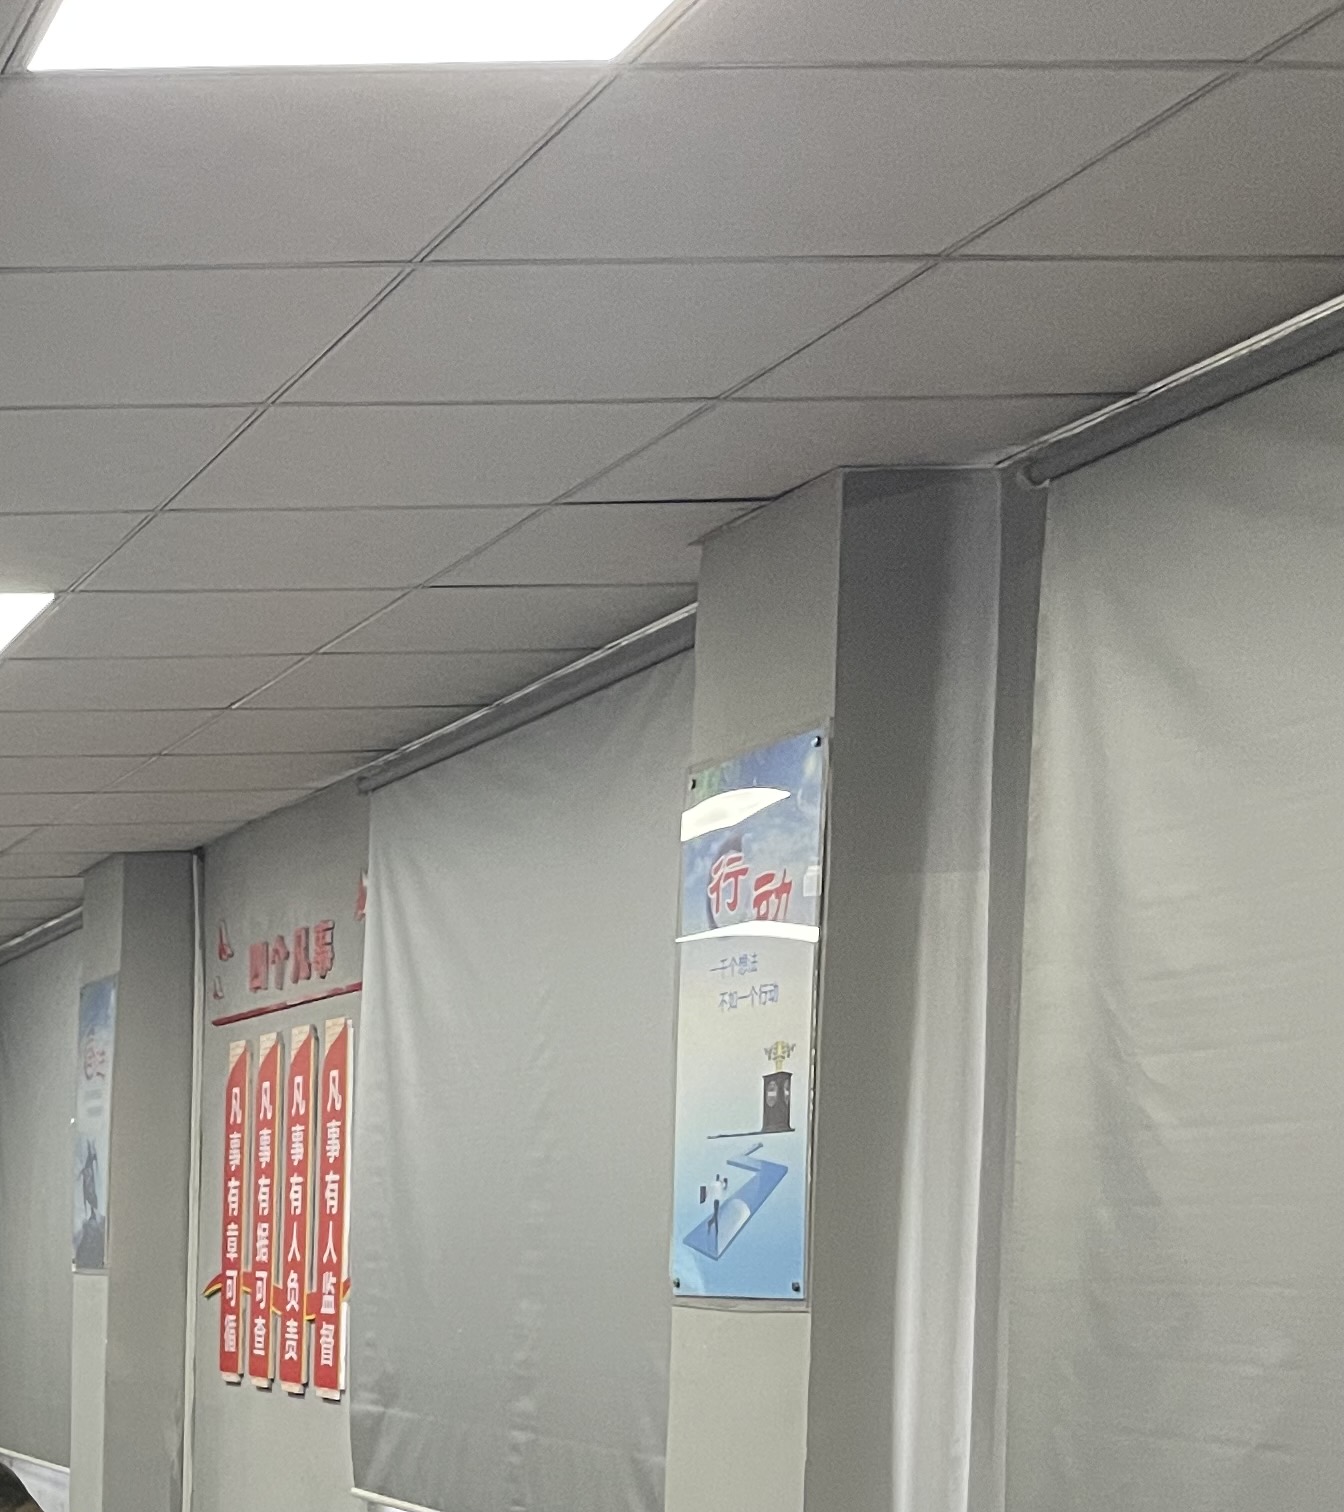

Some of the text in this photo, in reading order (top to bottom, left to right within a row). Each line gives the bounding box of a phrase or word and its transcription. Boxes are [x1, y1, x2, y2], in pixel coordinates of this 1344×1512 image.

[708, 852, 793, 921] 行动
[284, 1075, 306, 1361] 凡事有人负责
[320, 1069, 343, 1367] 凡事有人监督
